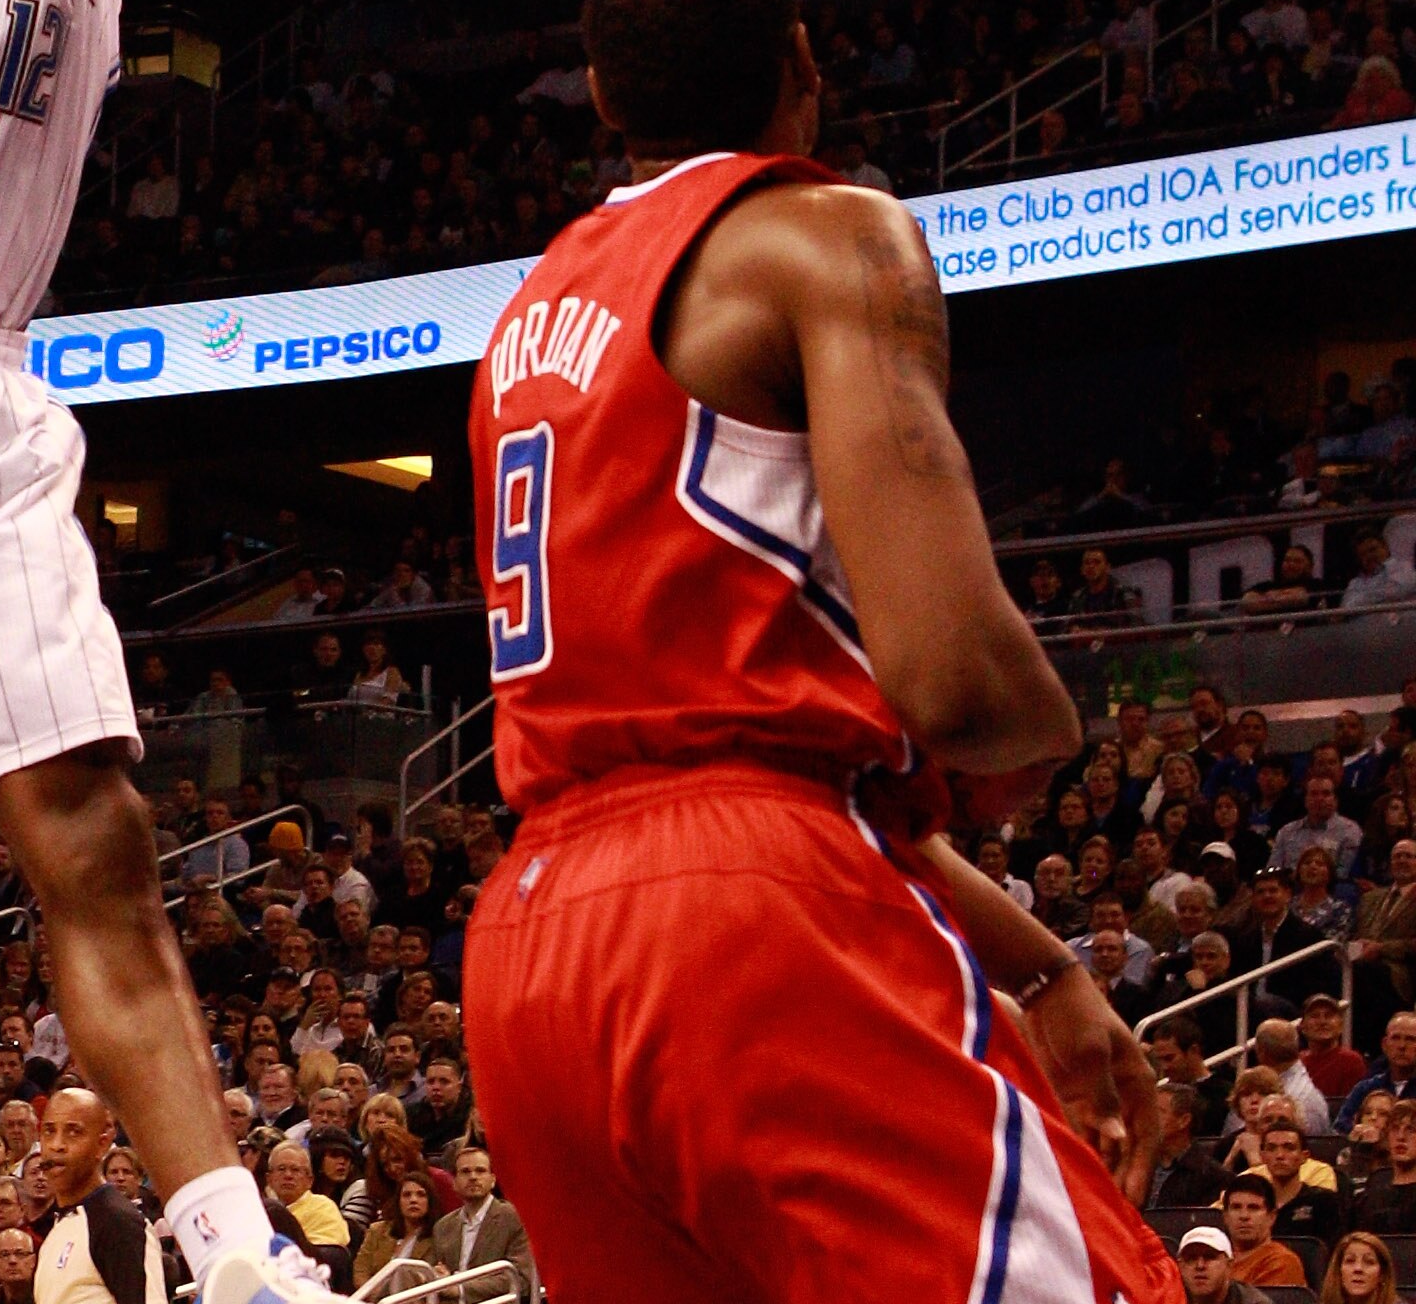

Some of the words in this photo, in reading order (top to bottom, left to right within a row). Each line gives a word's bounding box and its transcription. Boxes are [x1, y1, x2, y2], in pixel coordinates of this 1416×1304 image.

[938, 202, 988, 237] the
[998, 191, 1074, 228] Club
[1085, 173, 1150, 213] and
[1161, 163, 1223, 204] IOA
[1235, 142, 1390, 192] Founders
[1008, 217, 1152, 275] products
[1163, 204, 1229, 246] and
[1240, 186, 1375, 235] services
[29, 328, 166, 389] ICO
[254, 320, 442, 373] PEPSICO
[491, 296, 622, 419] JORDAN
[488, 420, 555, 684] 9
